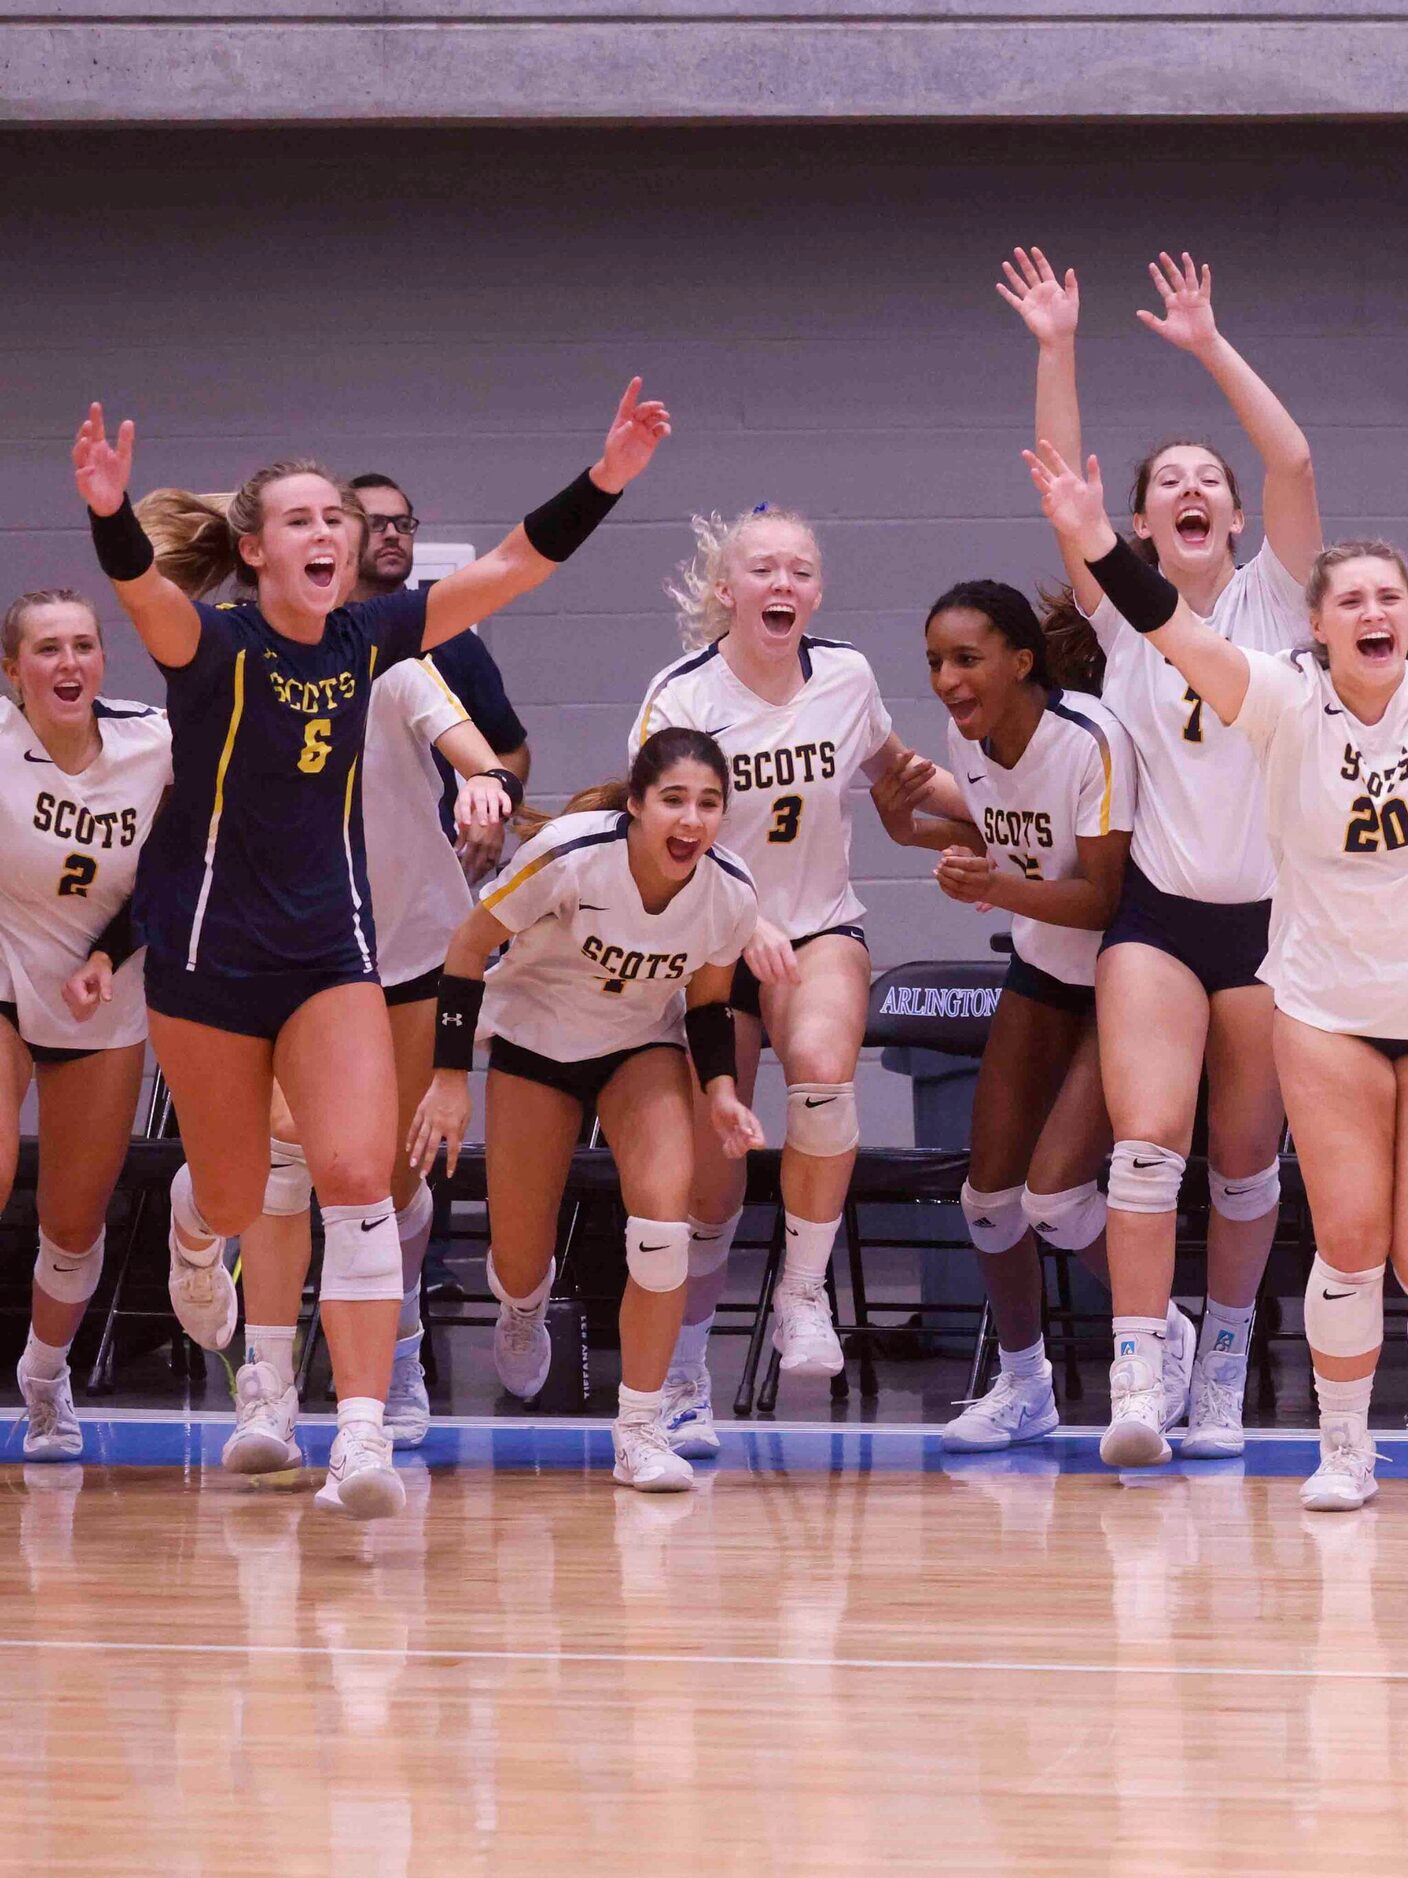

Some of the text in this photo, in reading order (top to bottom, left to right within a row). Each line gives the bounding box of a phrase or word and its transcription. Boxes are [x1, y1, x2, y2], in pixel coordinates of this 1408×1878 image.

[270, 671, 356, 713] SCOTS
[297, 718, 333, 773] 6
[732, 740, 837, 792] SCOTS
[33, 791, 137, 848] SCOTS
[768, 793, 805, 844] 3
[984, 806, 1054, 848] SCOTS
[57, 851, 98, 898] 2
[580, 935, 688, 980] SCOTS
[879, 985, 1002, 1018] ARLINGTON
